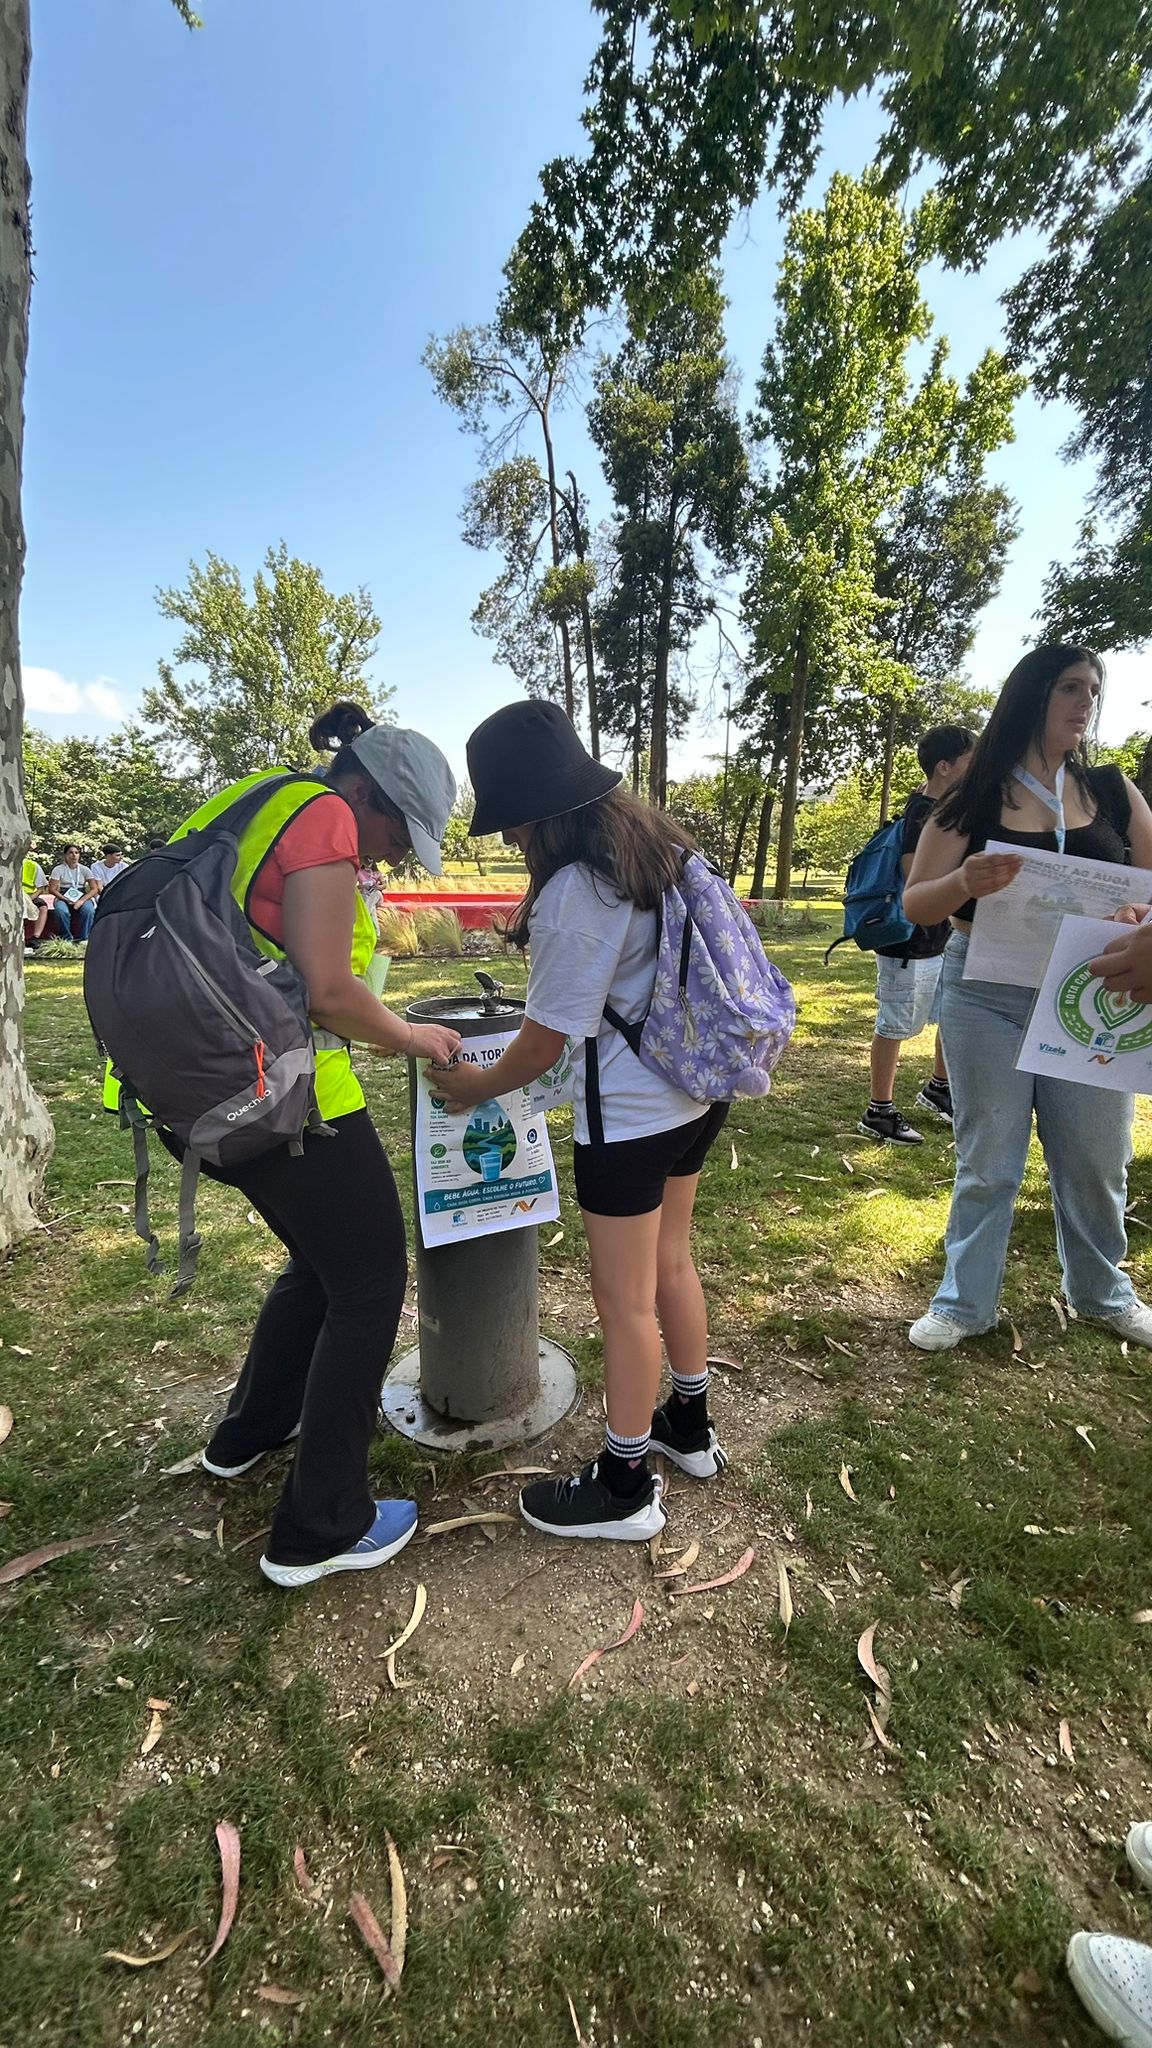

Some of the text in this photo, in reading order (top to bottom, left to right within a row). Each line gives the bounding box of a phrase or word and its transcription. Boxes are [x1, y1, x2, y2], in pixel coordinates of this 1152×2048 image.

[1065, 985, 1080, 1005] ROTA
[462, 1052, 478, 1063] DA
[480, 1048, 505, 1062] TOR
[1039, 1043, 1067, 1055] Vizela
[443, 1192, 461, 1201] BEBE
